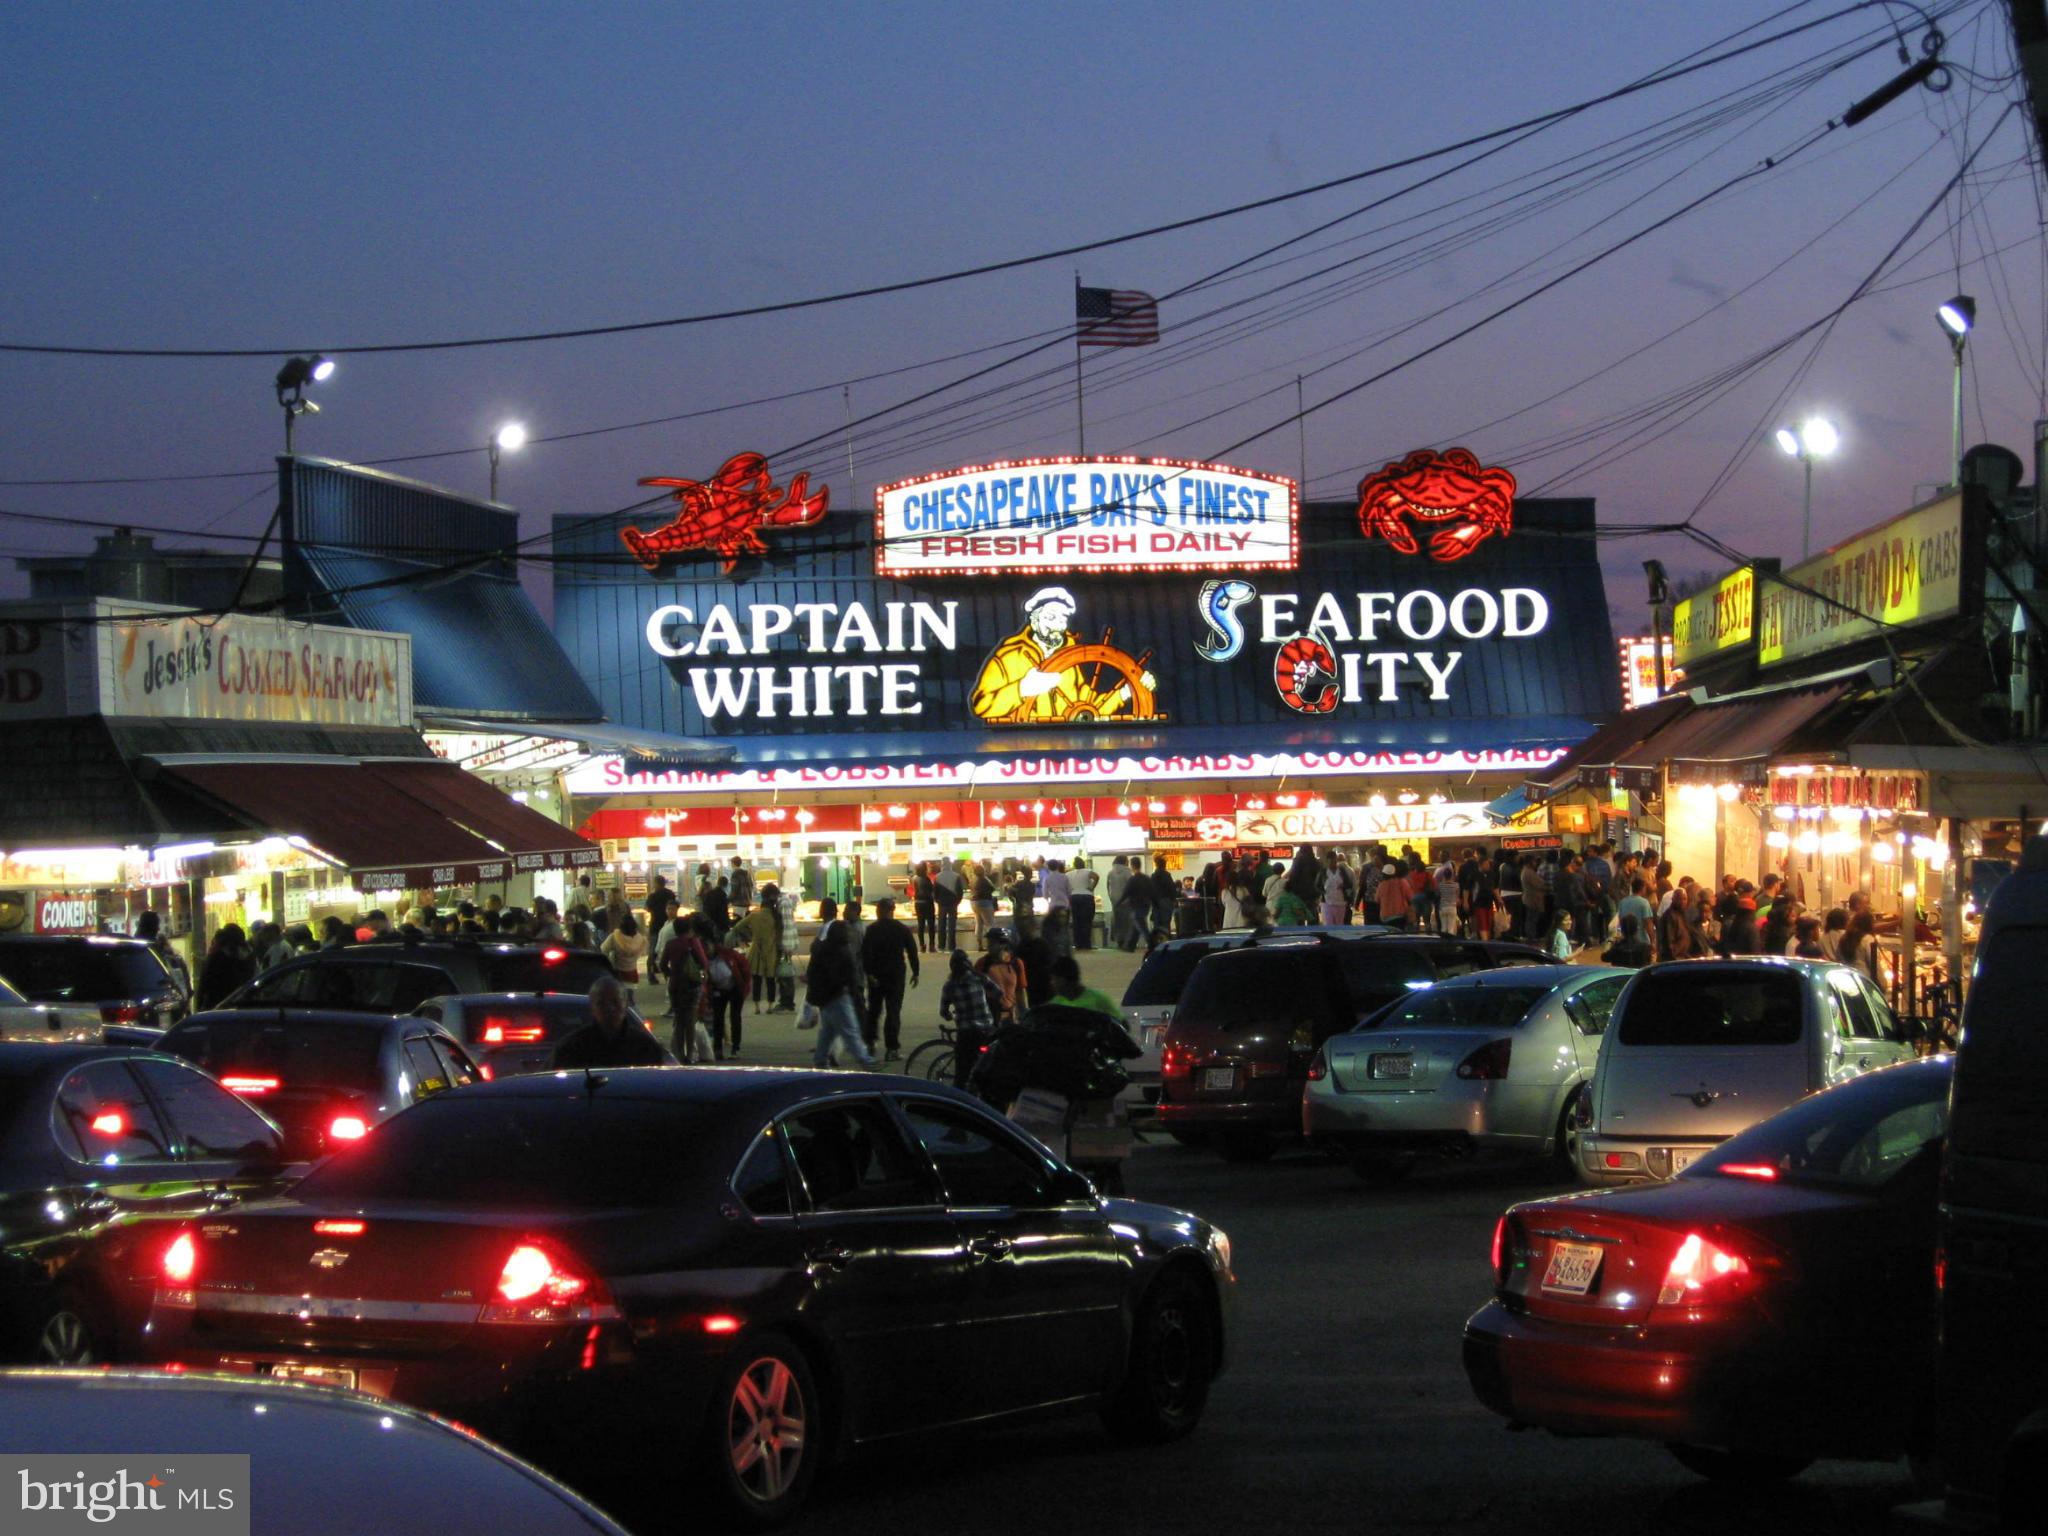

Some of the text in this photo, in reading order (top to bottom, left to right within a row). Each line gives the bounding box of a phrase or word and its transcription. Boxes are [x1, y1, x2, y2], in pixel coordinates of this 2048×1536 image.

[903, 473, 1270, 532] CHESAPEAKE BAY'S FINEST
[921, 531, 1252, 557] FRESH FISH DAILY
[1821, 537, 1905, 632] SEAFOOD
[1919, 526, 1959, 588] CRABS
[646, 601, 959, 657] CAPTAIN
[1709, 577, 1751, 641] JESSIE
[143, 632, 212, 695] Jessie's
[688, 664, 922, 718] WHITE
[1281, 810, 1438, 836] CRAB SALE
[42, 901, 86, 929] COOKED
